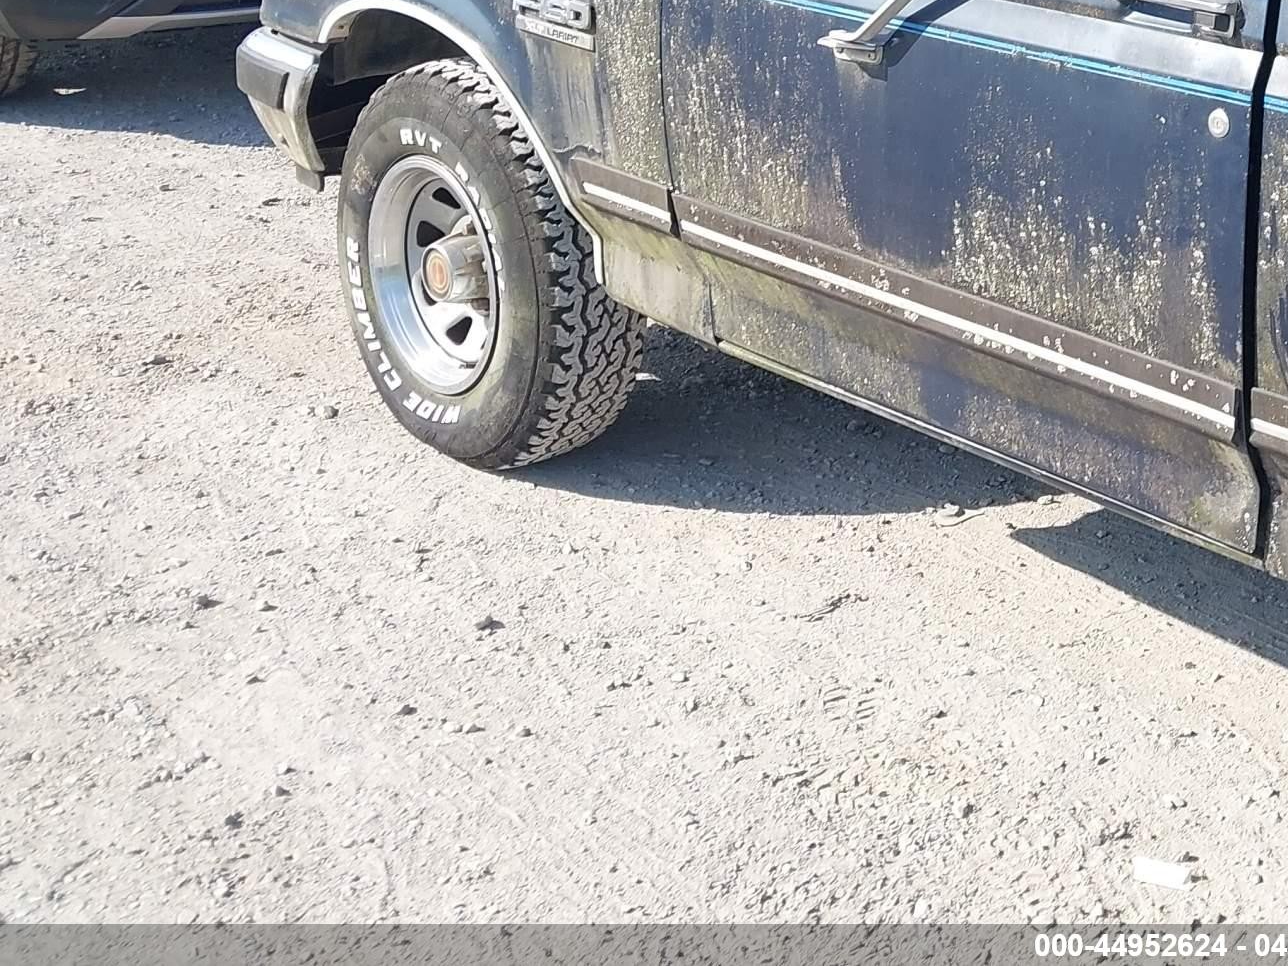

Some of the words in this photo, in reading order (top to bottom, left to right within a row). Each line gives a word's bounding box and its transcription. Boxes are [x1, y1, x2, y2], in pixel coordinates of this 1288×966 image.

[399, 127, 443, 154] RVT
[345, 236, 403, 392] CLIMBER
[402, 390, 463, 425] WIDE
